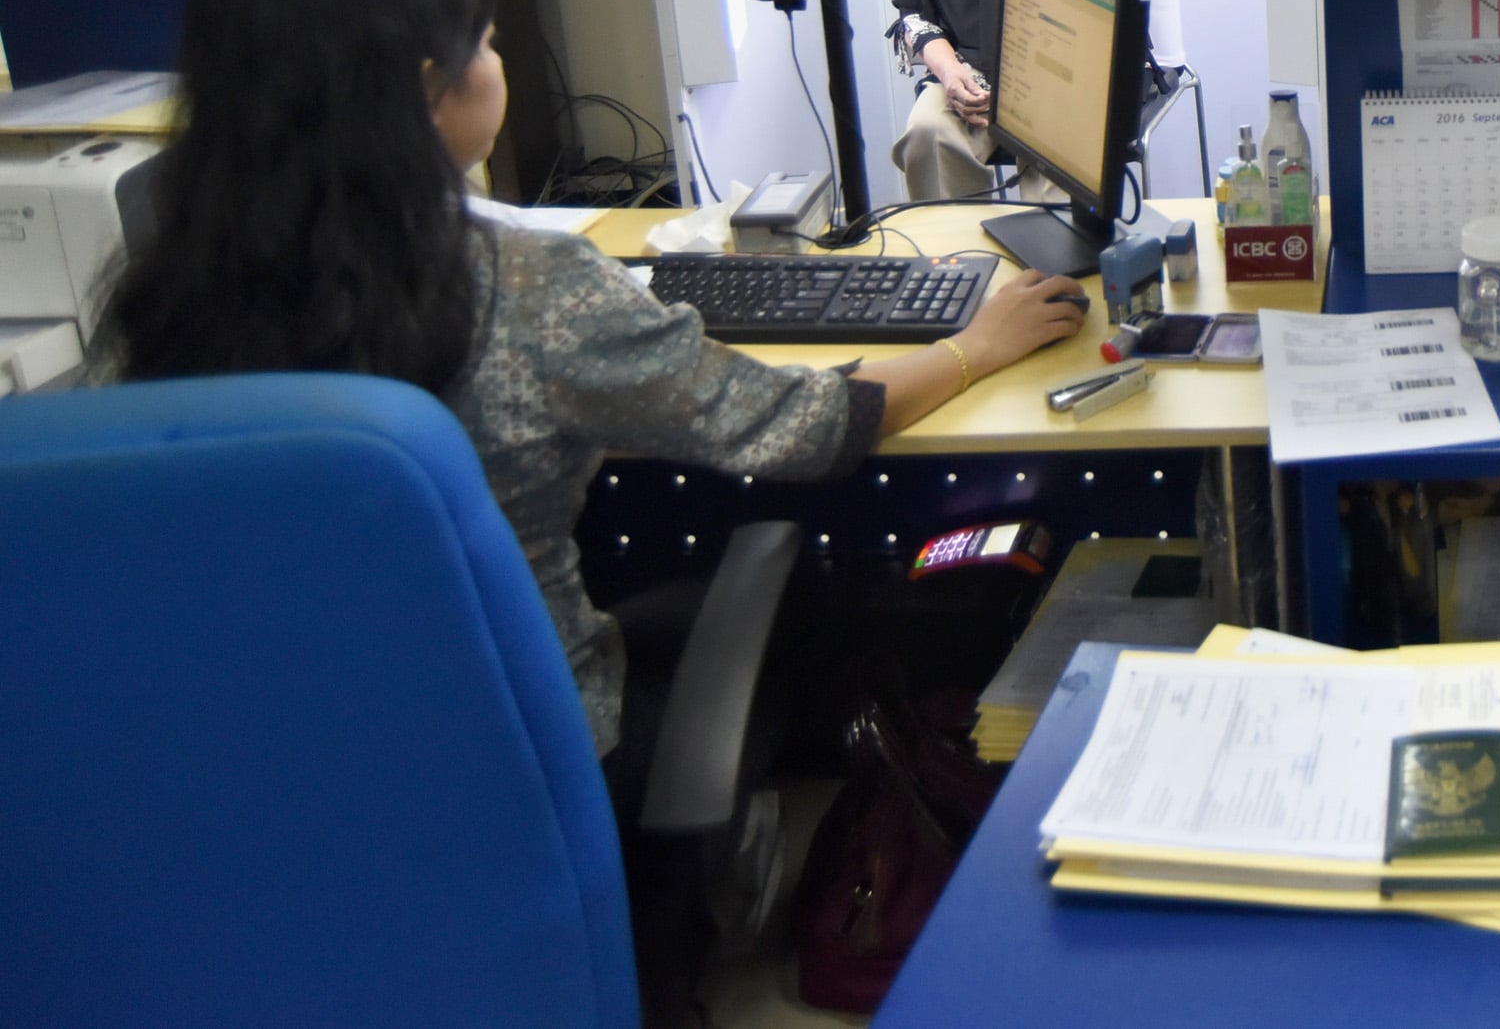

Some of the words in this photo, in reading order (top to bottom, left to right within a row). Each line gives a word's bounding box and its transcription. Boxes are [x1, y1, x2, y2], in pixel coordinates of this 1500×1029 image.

[1371, 115, 1395, 126] ACA
[1436, 113, 1465, 124] 2016
[1233, 241, 1277, 258] ICBC
